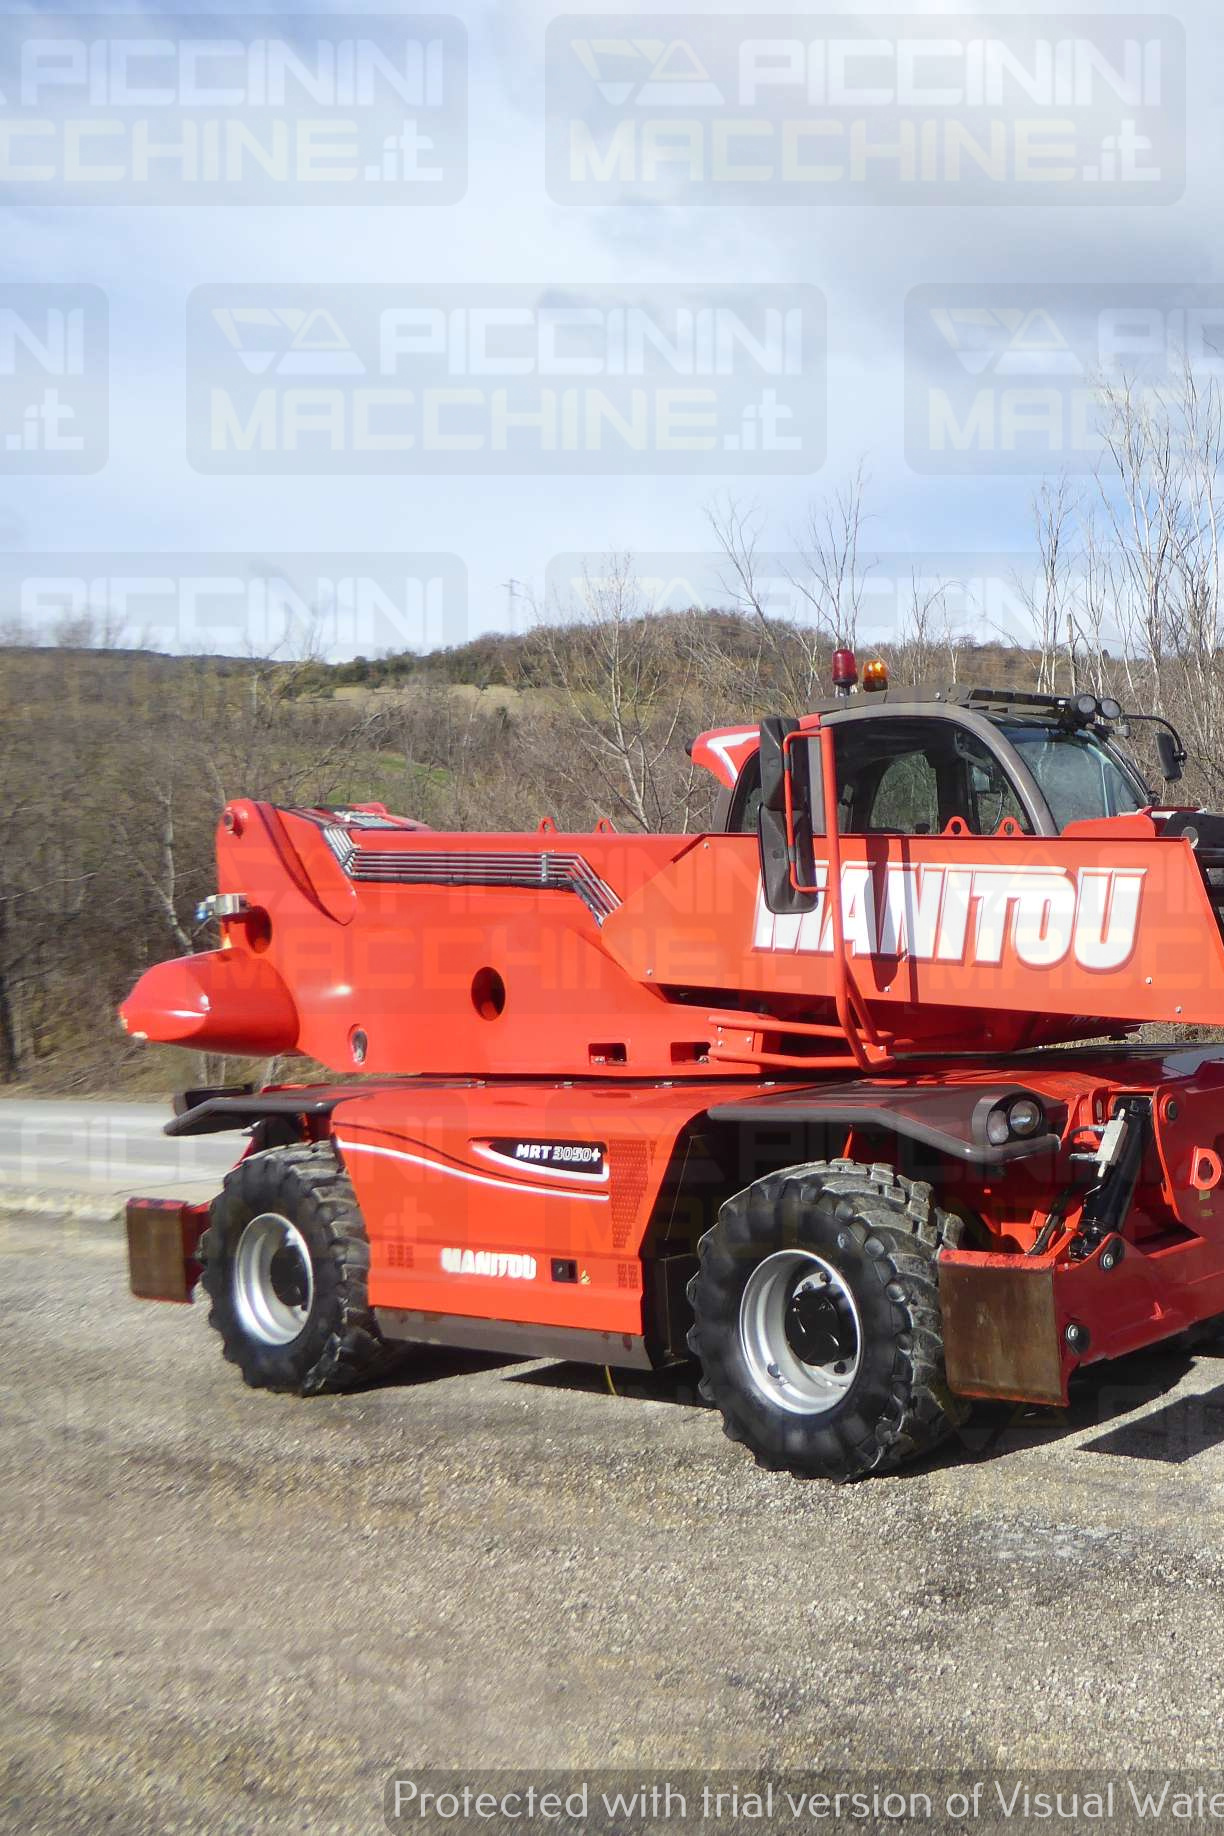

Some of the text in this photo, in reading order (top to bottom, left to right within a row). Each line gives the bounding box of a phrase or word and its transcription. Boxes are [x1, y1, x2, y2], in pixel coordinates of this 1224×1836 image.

[752, 860, 1148, 973] MANITOU
[515, 1143, 602, 1162] MRT 3050+
[441, 1247, 537, 1280] MANITOU
